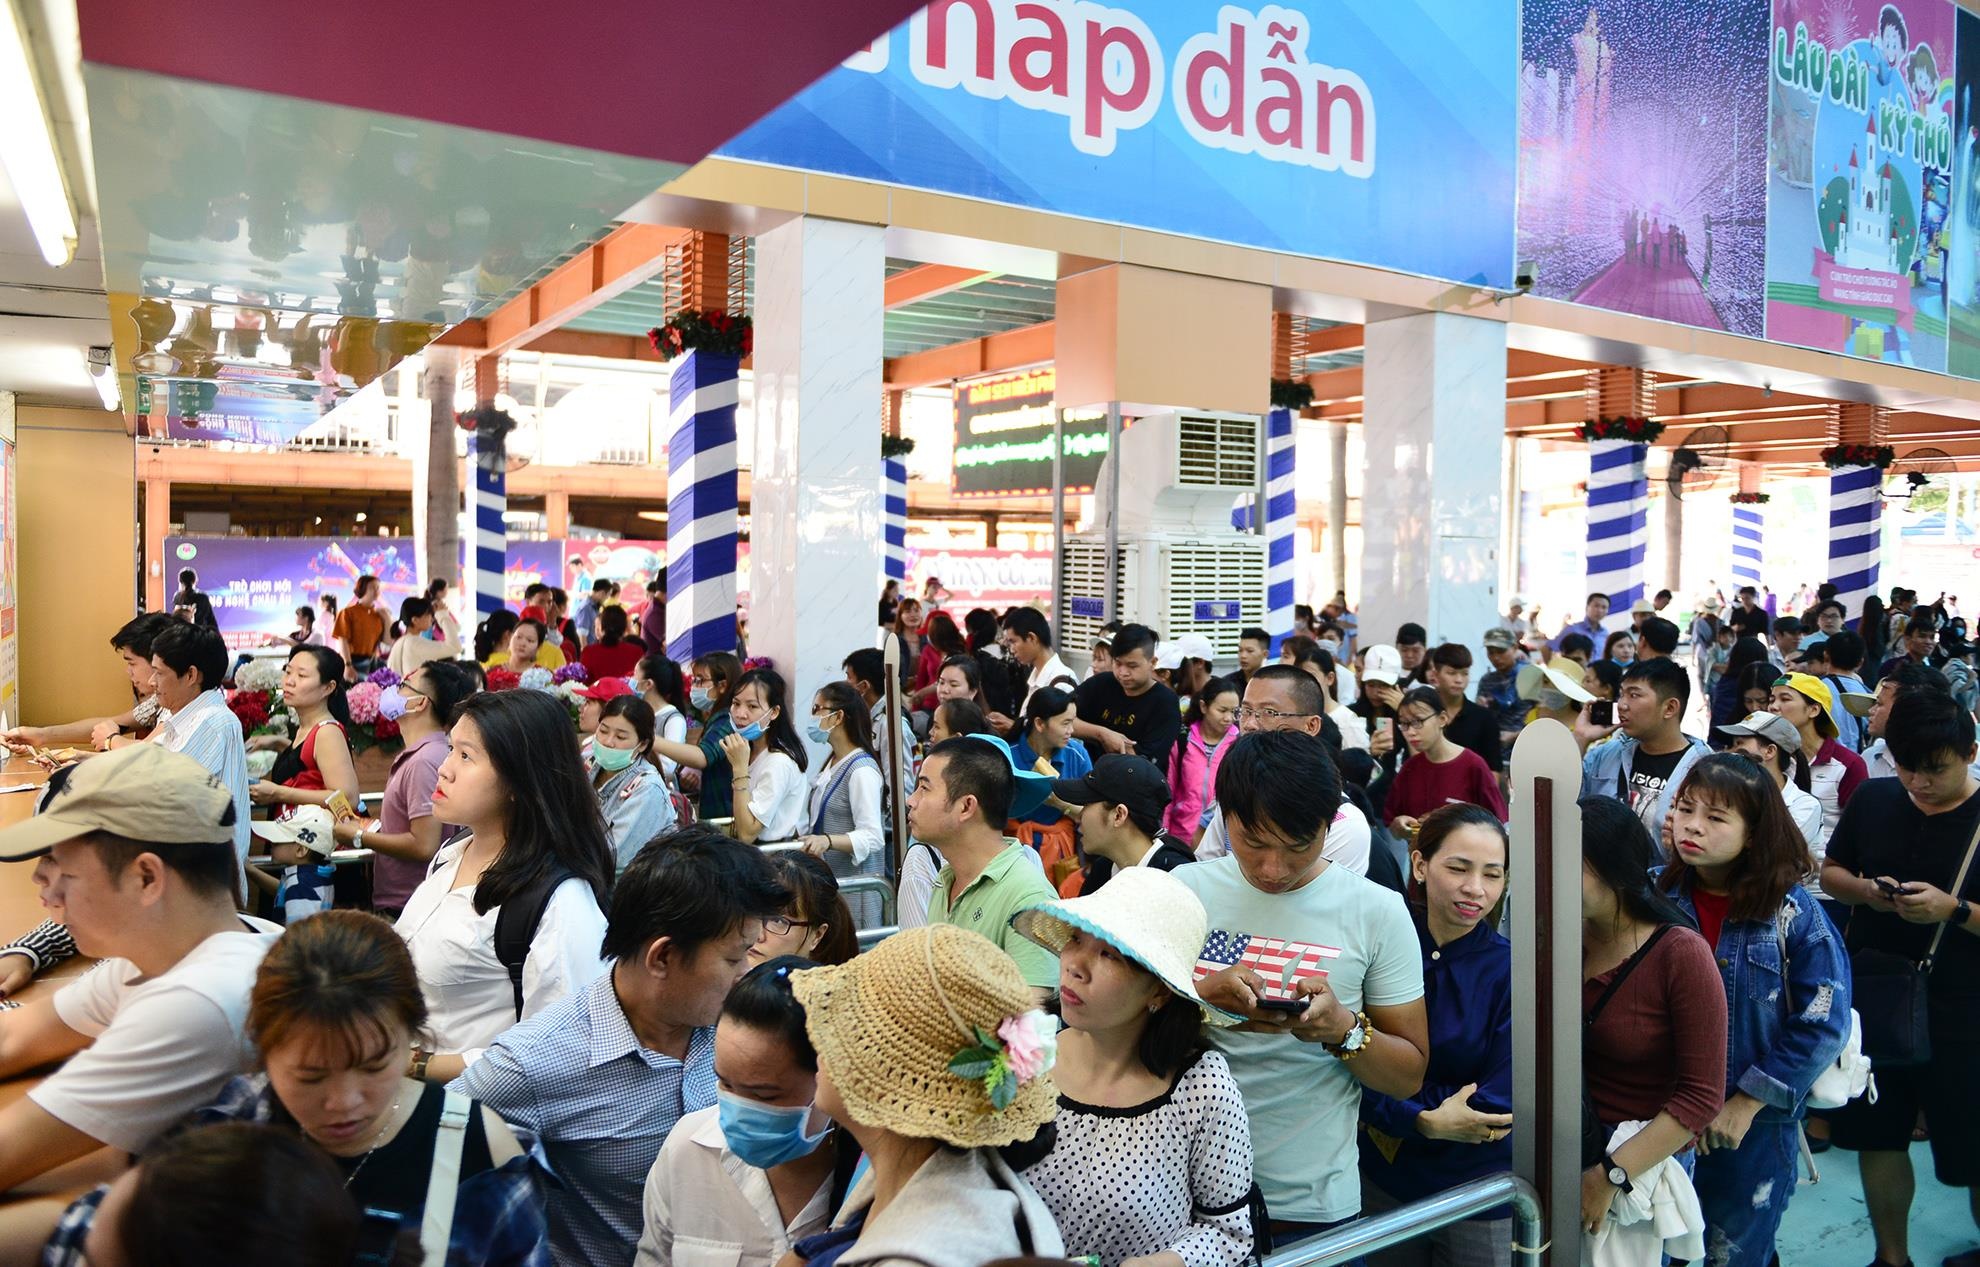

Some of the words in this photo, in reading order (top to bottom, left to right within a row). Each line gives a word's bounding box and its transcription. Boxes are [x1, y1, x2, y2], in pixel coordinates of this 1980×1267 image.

[1185, 21, 1364, 163] dẫn
[1777, 23, 1826, 94] LÂU
[1828, 48, 1869, 112] ĐÀI
[297, 828, 318, 844] 26
